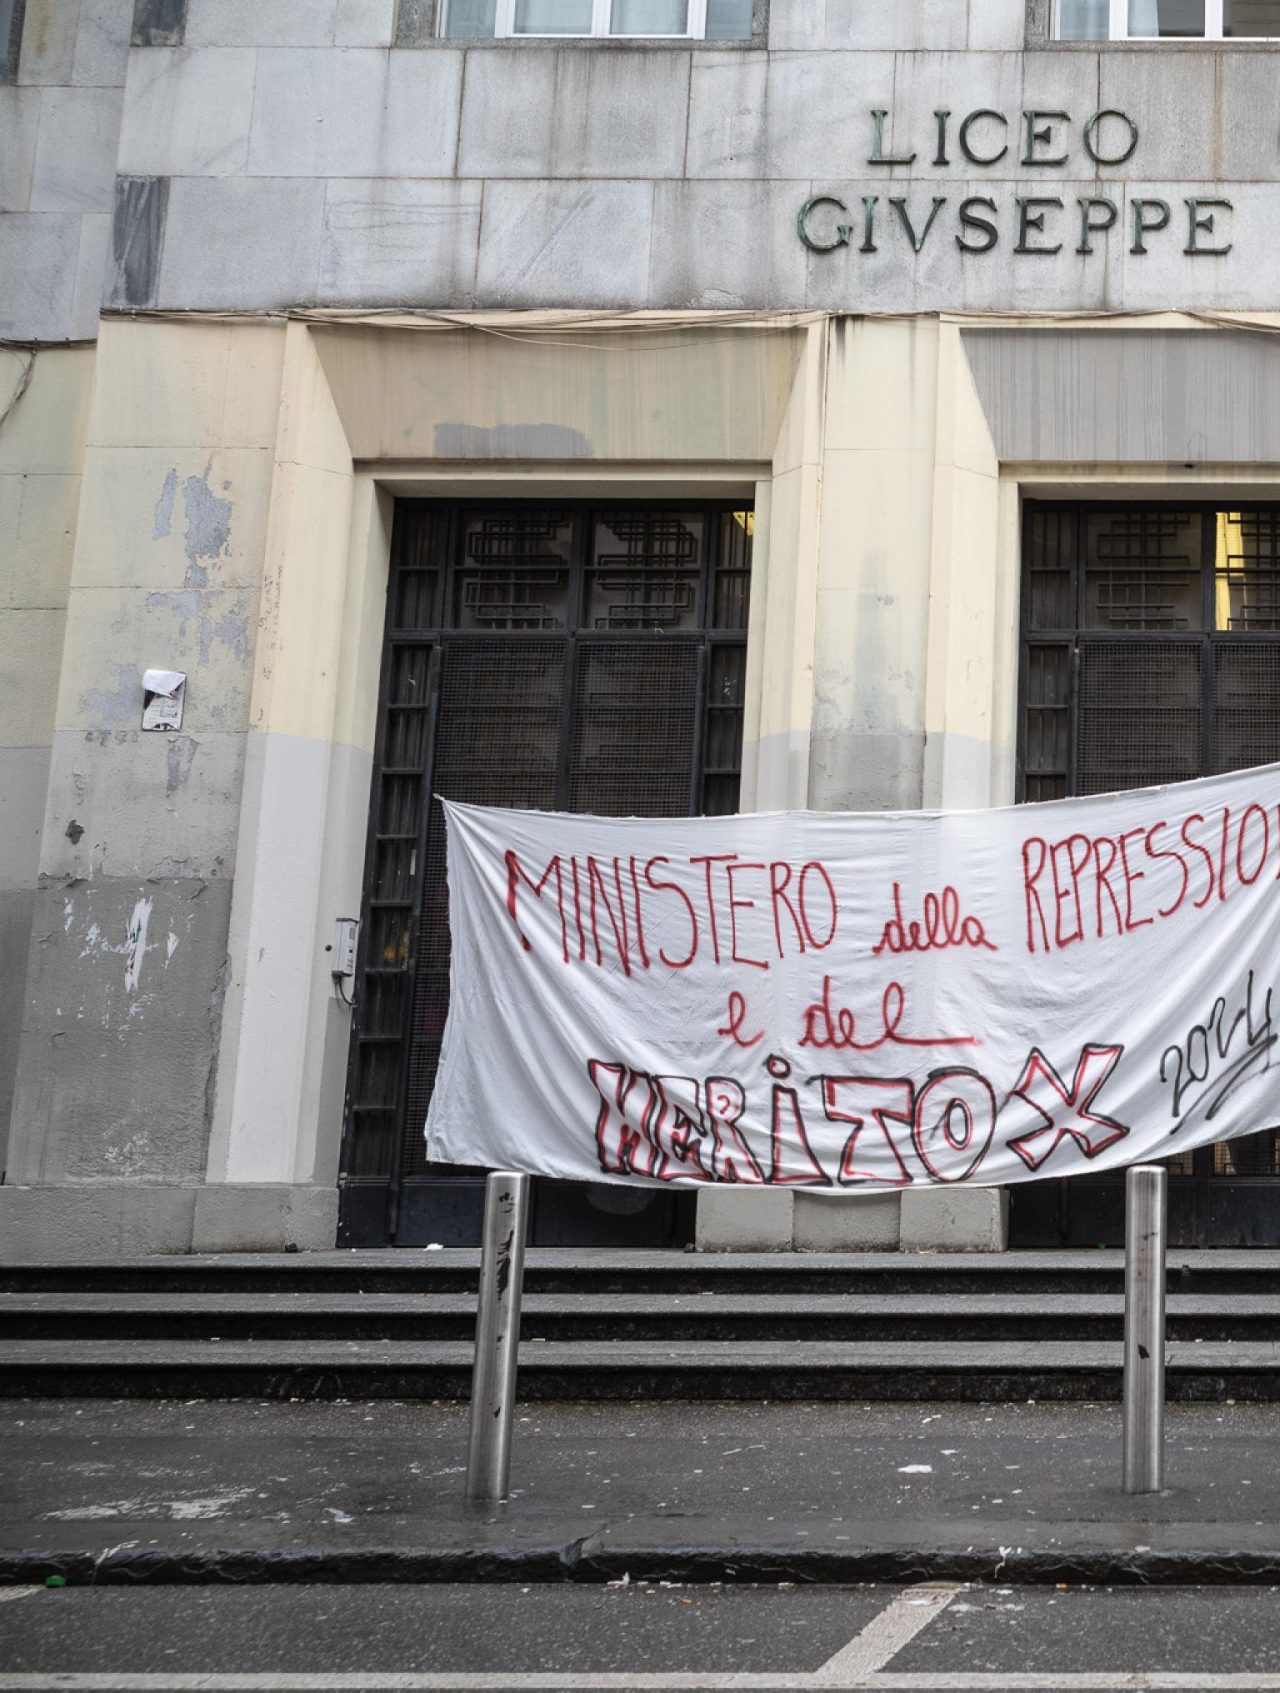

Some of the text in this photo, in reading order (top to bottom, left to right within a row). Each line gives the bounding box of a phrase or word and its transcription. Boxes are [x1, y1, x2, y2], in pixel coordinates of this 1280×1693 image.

[866, 109, 1139, 166] LICEO
[796, 195, 1233, 255] GIVSEPPE
[504, 848, 838, 977] MINISTERO
[872, 882, 998, 957] della
[717, 974, 978, 1050] e del
[1159, 969, 1276, 1119] 2024
